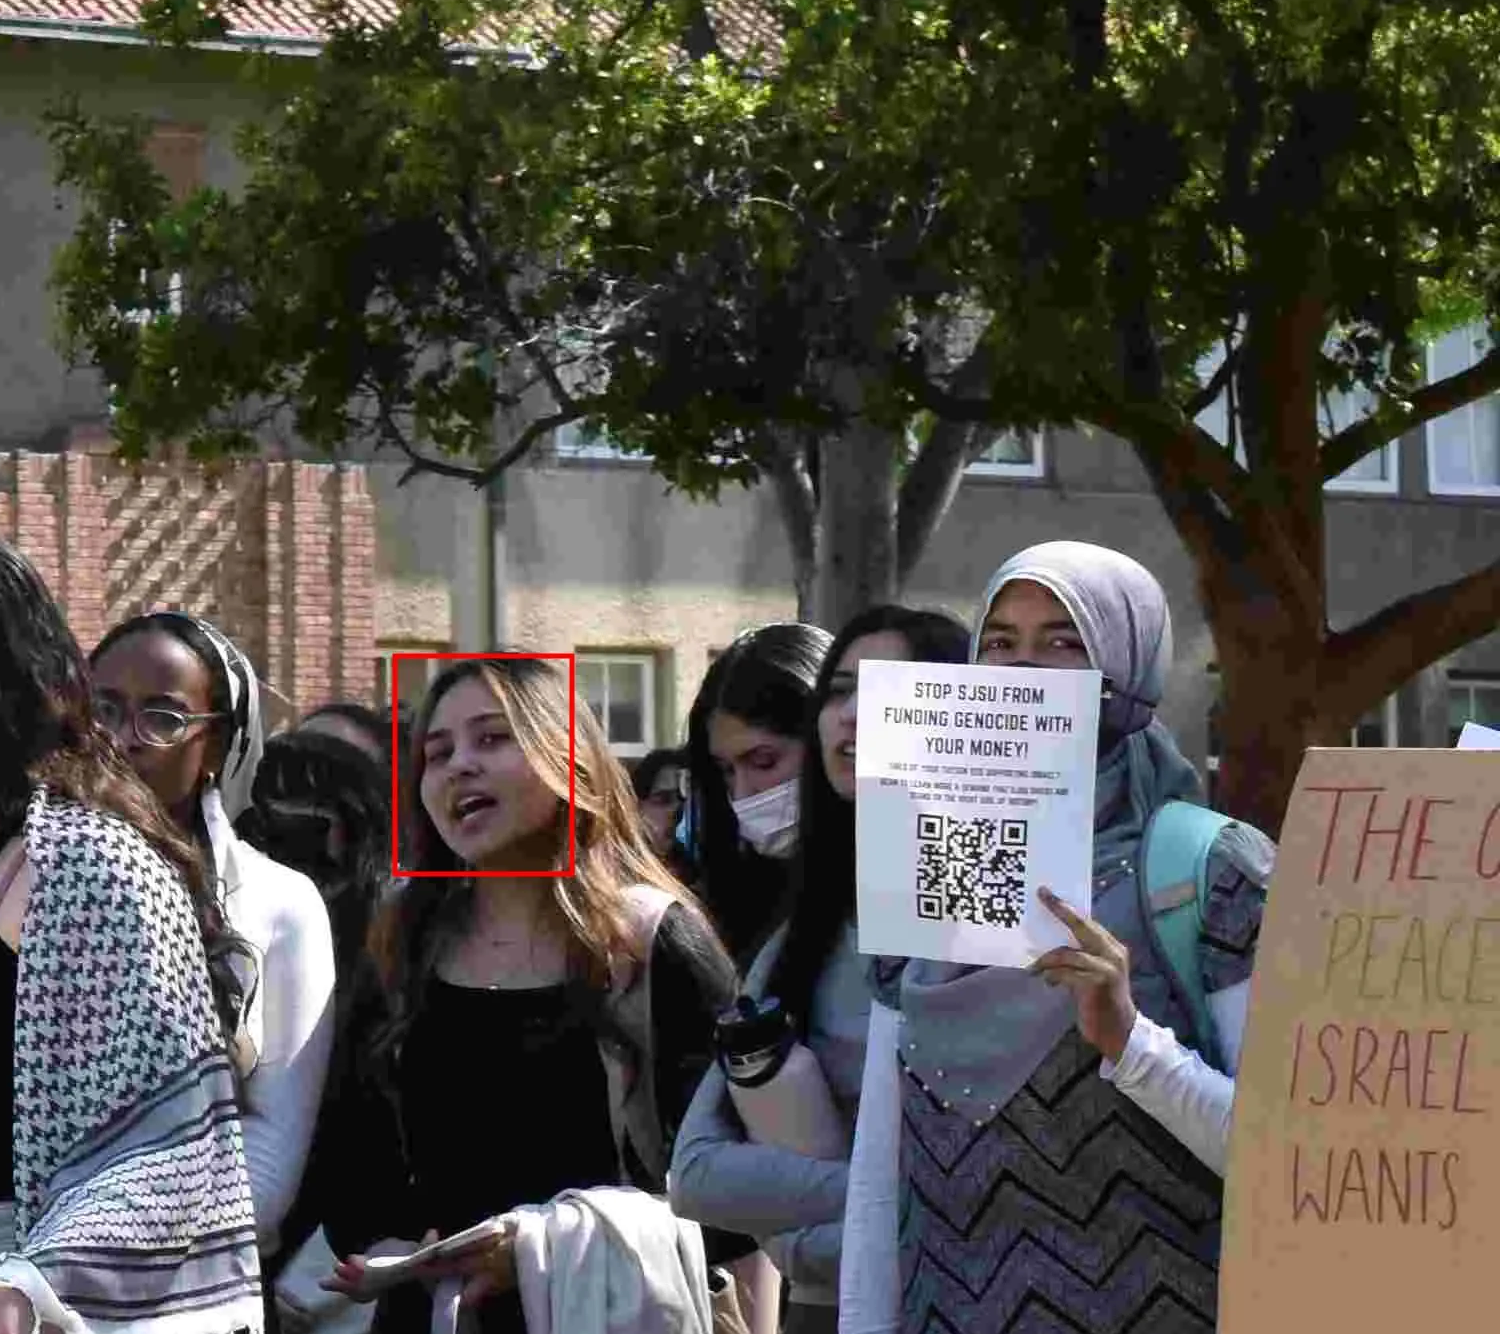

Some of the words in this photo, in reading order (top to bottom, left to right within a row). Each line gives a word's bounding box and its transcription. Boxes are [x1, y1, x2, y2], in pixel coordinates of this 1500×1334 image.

[884, 706, 949, 728] FUNDING
[954, 711, 1029, 731] GENOCIDE
[1034, 715, 1073, 734] WITH
[914, 681, 952, 701] STOP
[958, 684, 997, 703] SJSU
[1001, 686, 1045, 705] FROM
[924, 736, 964, 755] YOUR
[970, 739, 1029, 759] MONEY!
[1304, 785, 1455, 886] THE
[1289, 1022, 1486, 1115] ISRAEL
[1292, 1147, 1460, 1231] WANTS
